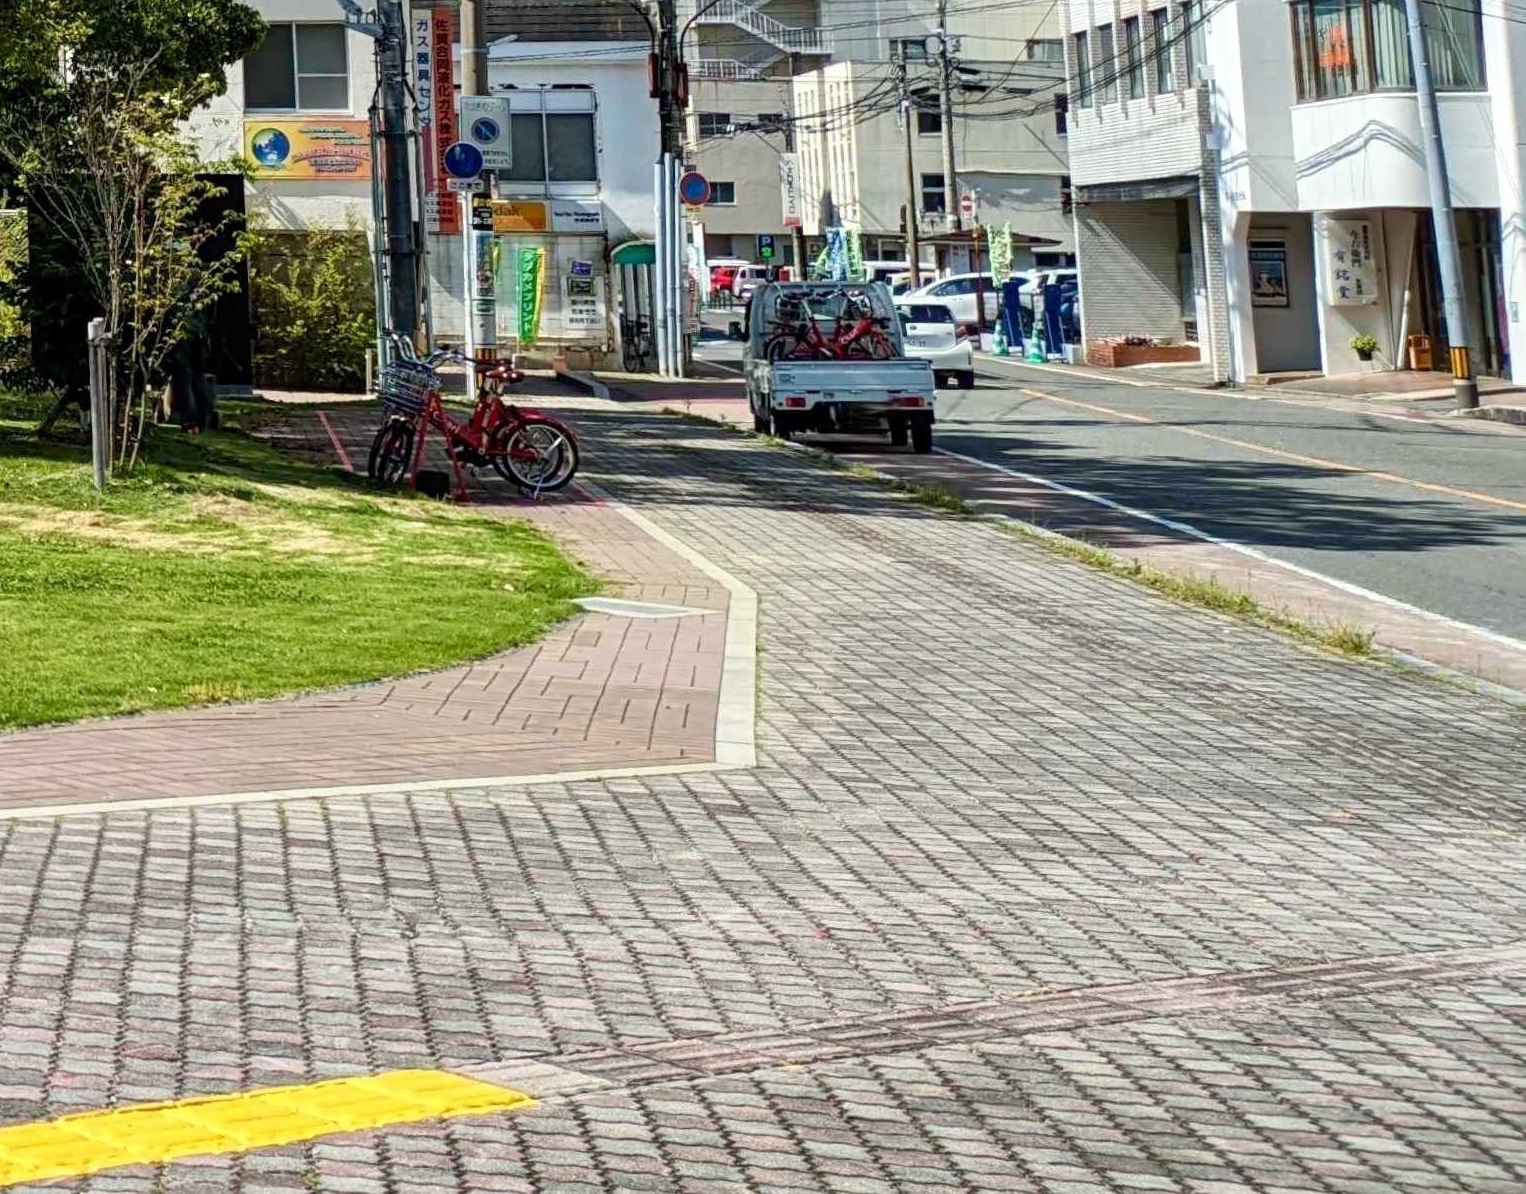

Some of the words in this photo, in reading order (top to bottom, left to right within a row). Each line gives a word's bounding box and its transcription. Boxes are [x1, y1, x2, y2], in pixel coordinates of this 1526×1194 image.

[416, 19, 432, 126] ガス器具センタ
[451, 181, 482, 190] ここまで
[494, 204, 520, 215] dak
[762, 236, 772, 246] P
